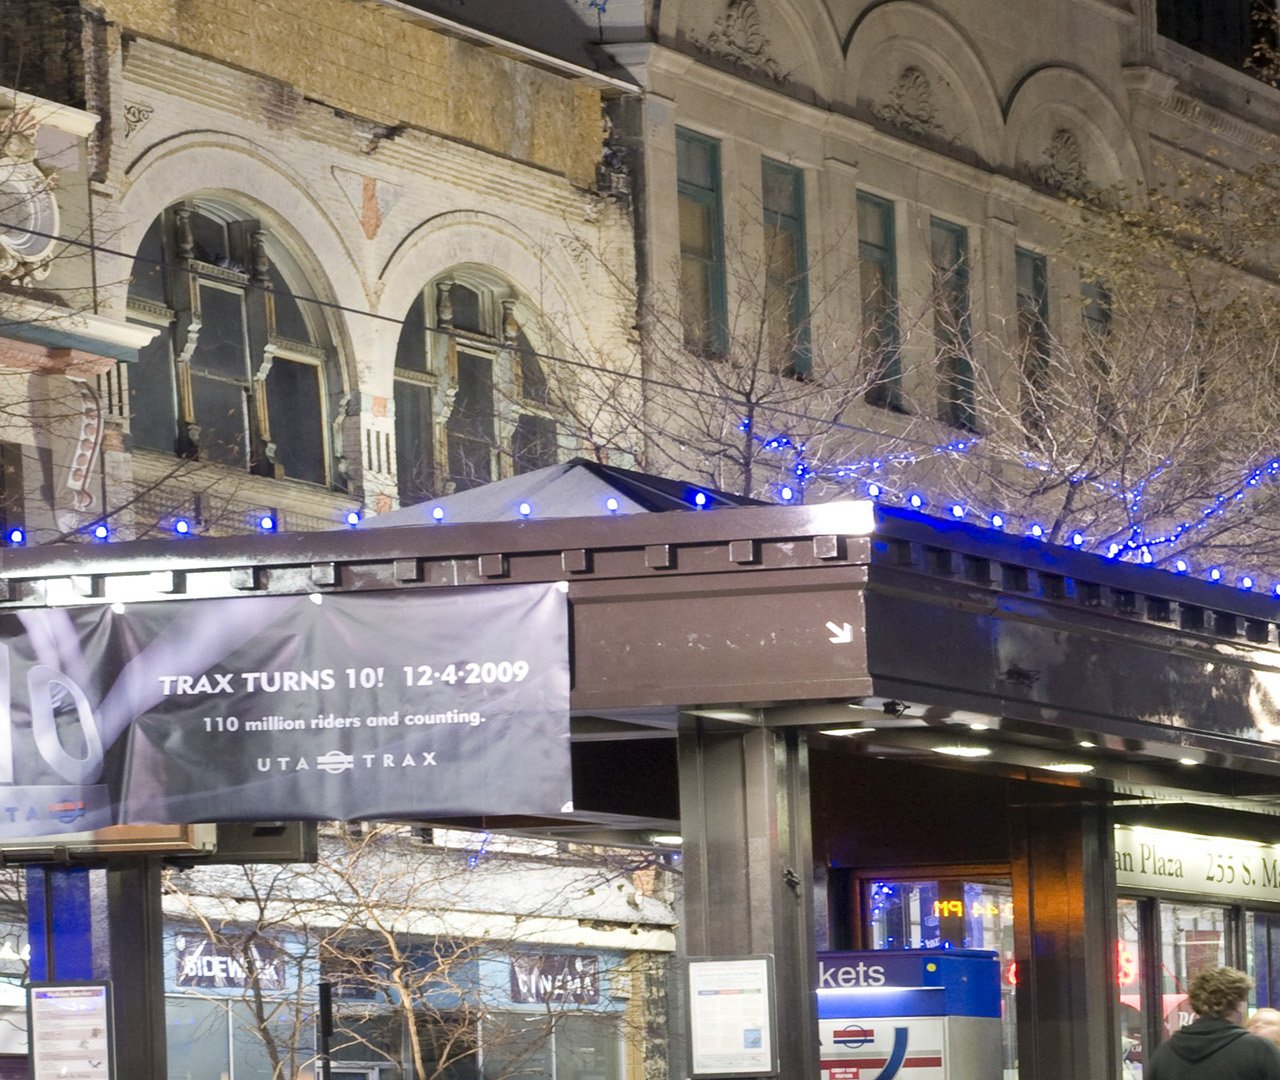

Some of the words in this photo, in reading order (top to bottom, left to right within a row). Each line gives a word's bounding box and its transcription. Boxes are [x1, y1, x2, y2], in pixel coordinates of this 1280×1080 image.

[158, 672, 235, 696] TRAX
[241, 668, 336, 693] TURNS
[345, 666, 384, 690] 10!
[203, 716, 239, 732] 110
[245, 713, 305, 732] million
[310, 714, 361, 730] riders
[366, 711, 399, 728] and
[404, 709, 487, 729] counting.
[257, 756, 310, 772] UTA
[362, 751, 438, 769] TRAX
[1139, 842, 1184, 879] Plaza
[1206, 852, 1236, 884] 255
[1241, 856, 1256, 886] S.
[184, 955, 280, 980] SIDEWK
[517, 973, 595, 995] CINEMA
